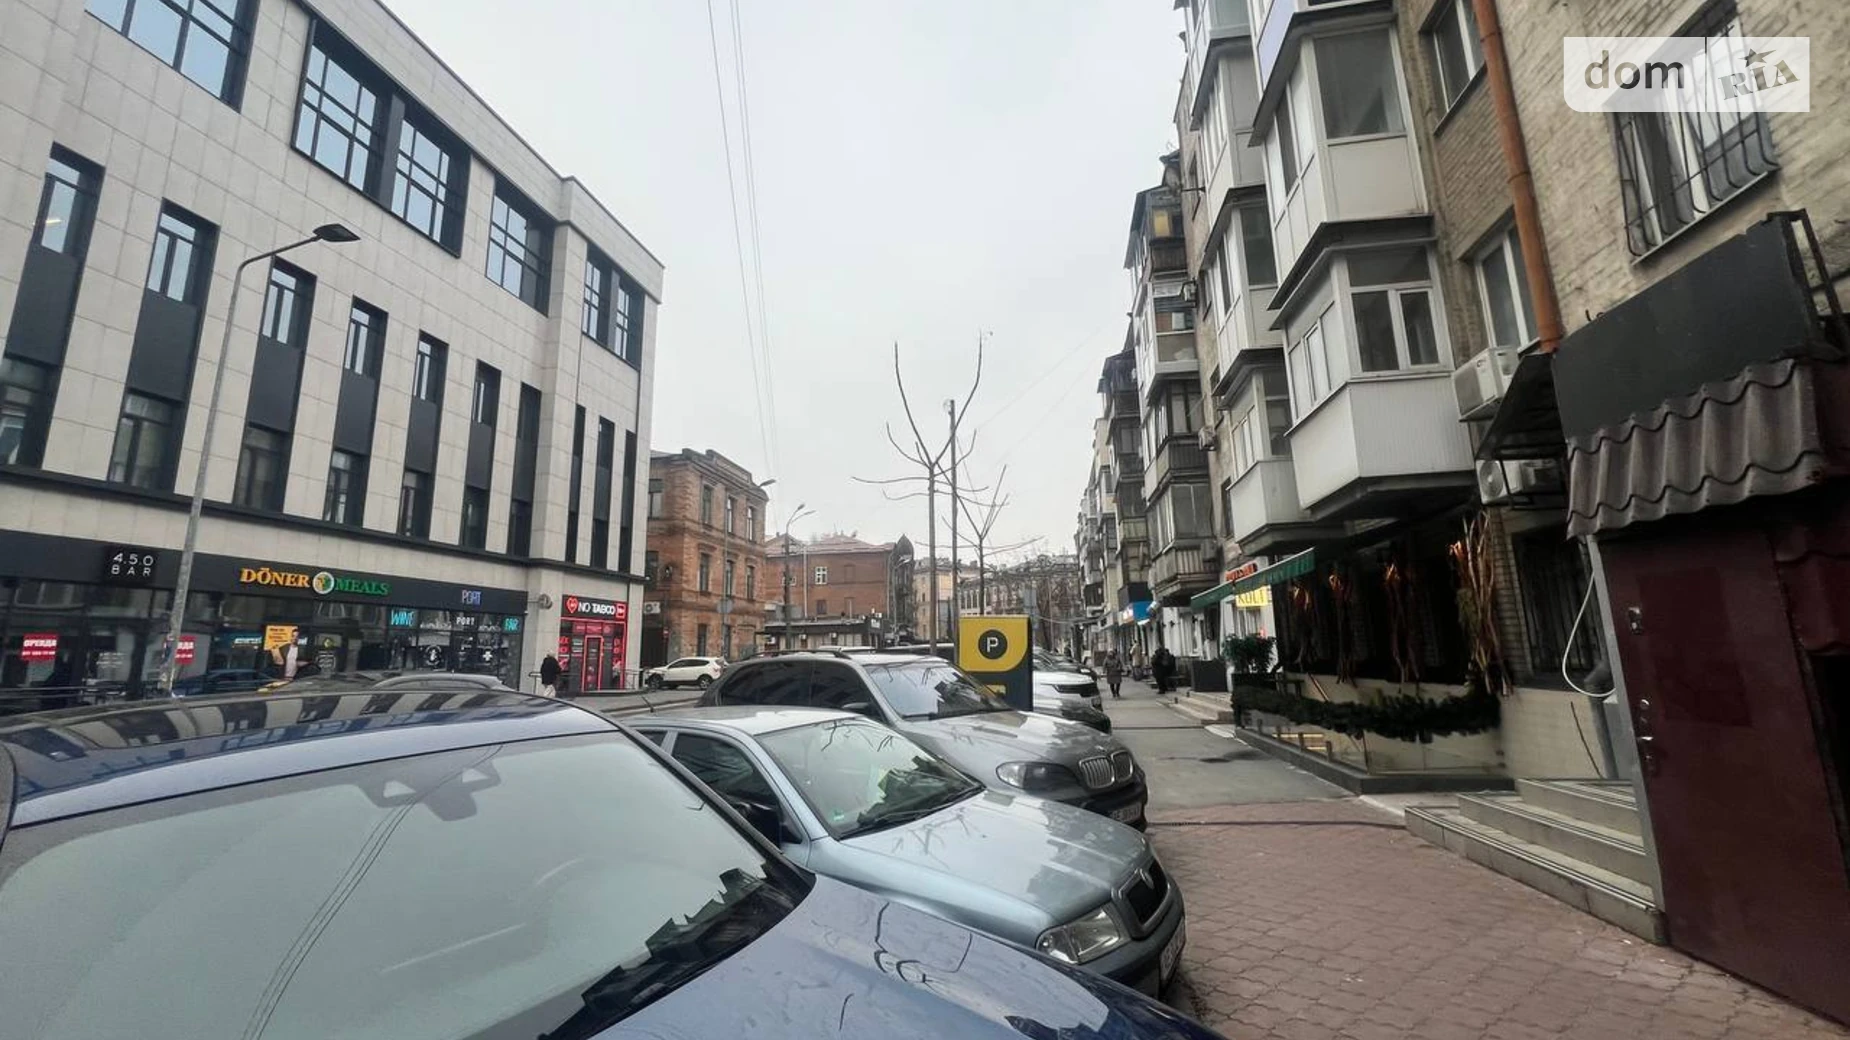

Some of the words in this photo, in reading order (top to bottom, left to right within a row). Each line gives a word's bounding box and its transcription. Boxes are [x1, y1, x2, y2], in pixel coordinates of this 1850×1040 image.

[111, 564, 151, 577] BAR
[334, 577, 389, 595] MEALS
[461, 590, 482, 605] PORT
[578, 602, 591, 613] NO
[456, 616, 475, 626] PORT
[986, 636, 999, 653] P
